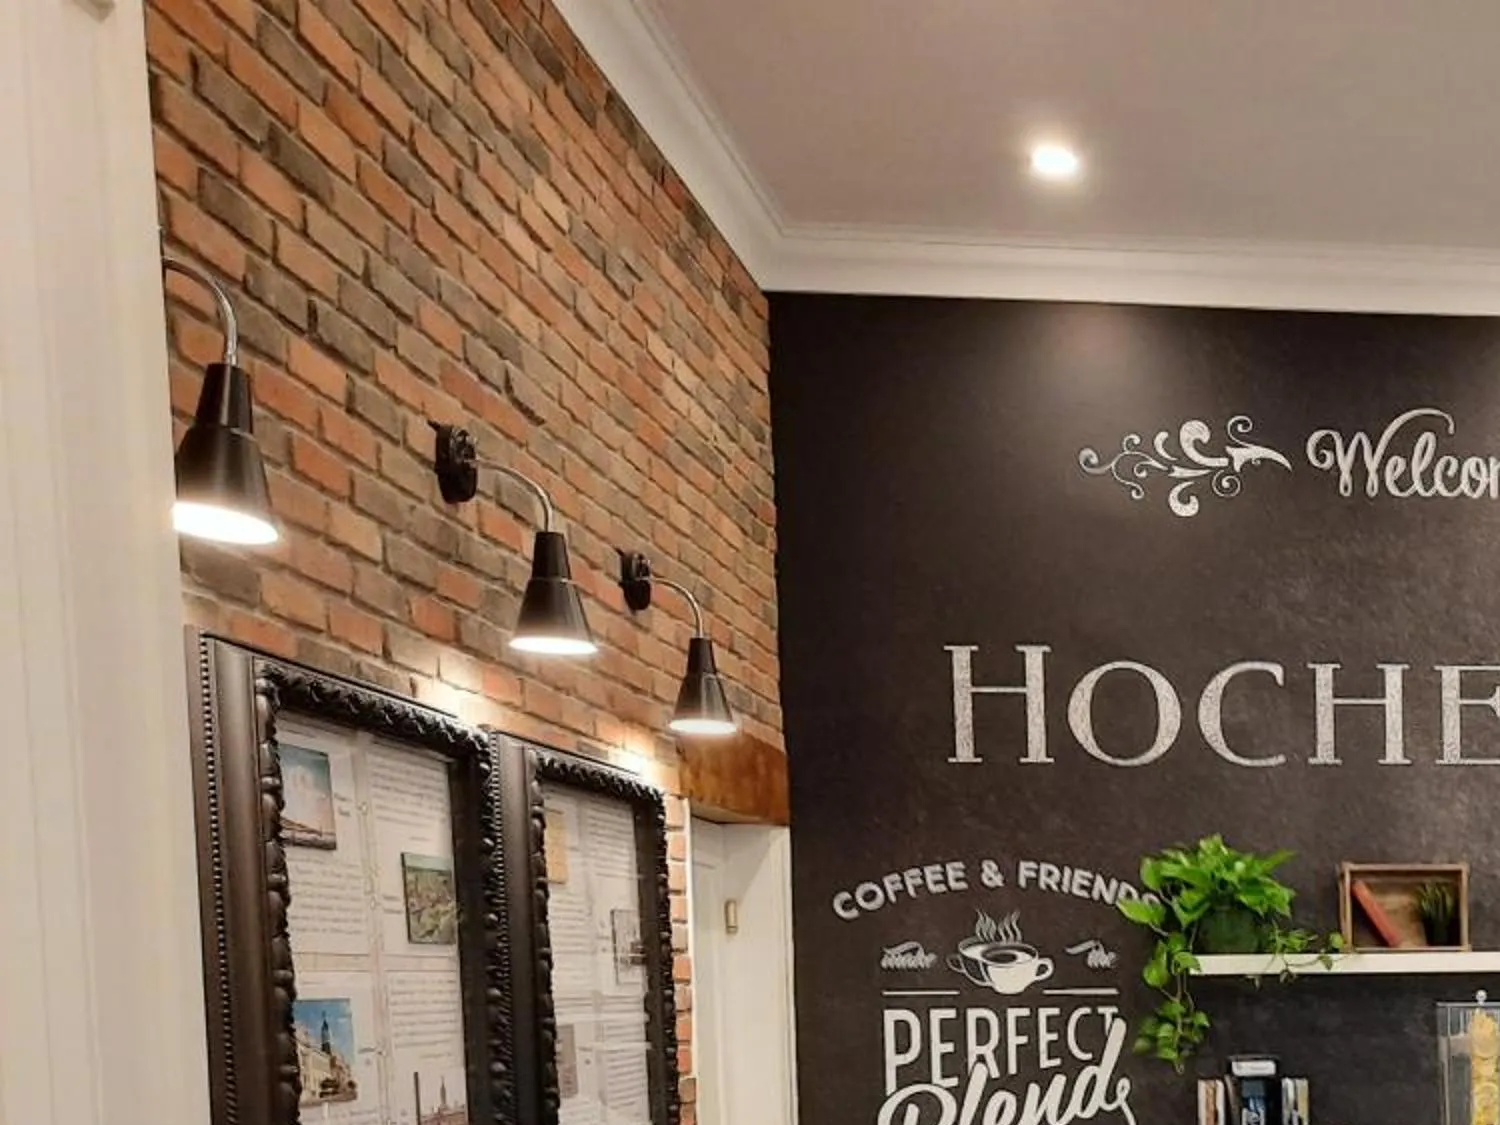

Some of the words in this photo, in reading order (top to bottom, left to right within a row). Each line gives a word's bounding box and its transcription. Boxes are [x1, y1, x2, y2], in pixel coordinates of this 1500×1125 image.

[832, 861, 969, 920] COFFEE
[981, 859, 1005, 889] &
[882, 1006, 1121, 1097] PERFECT
